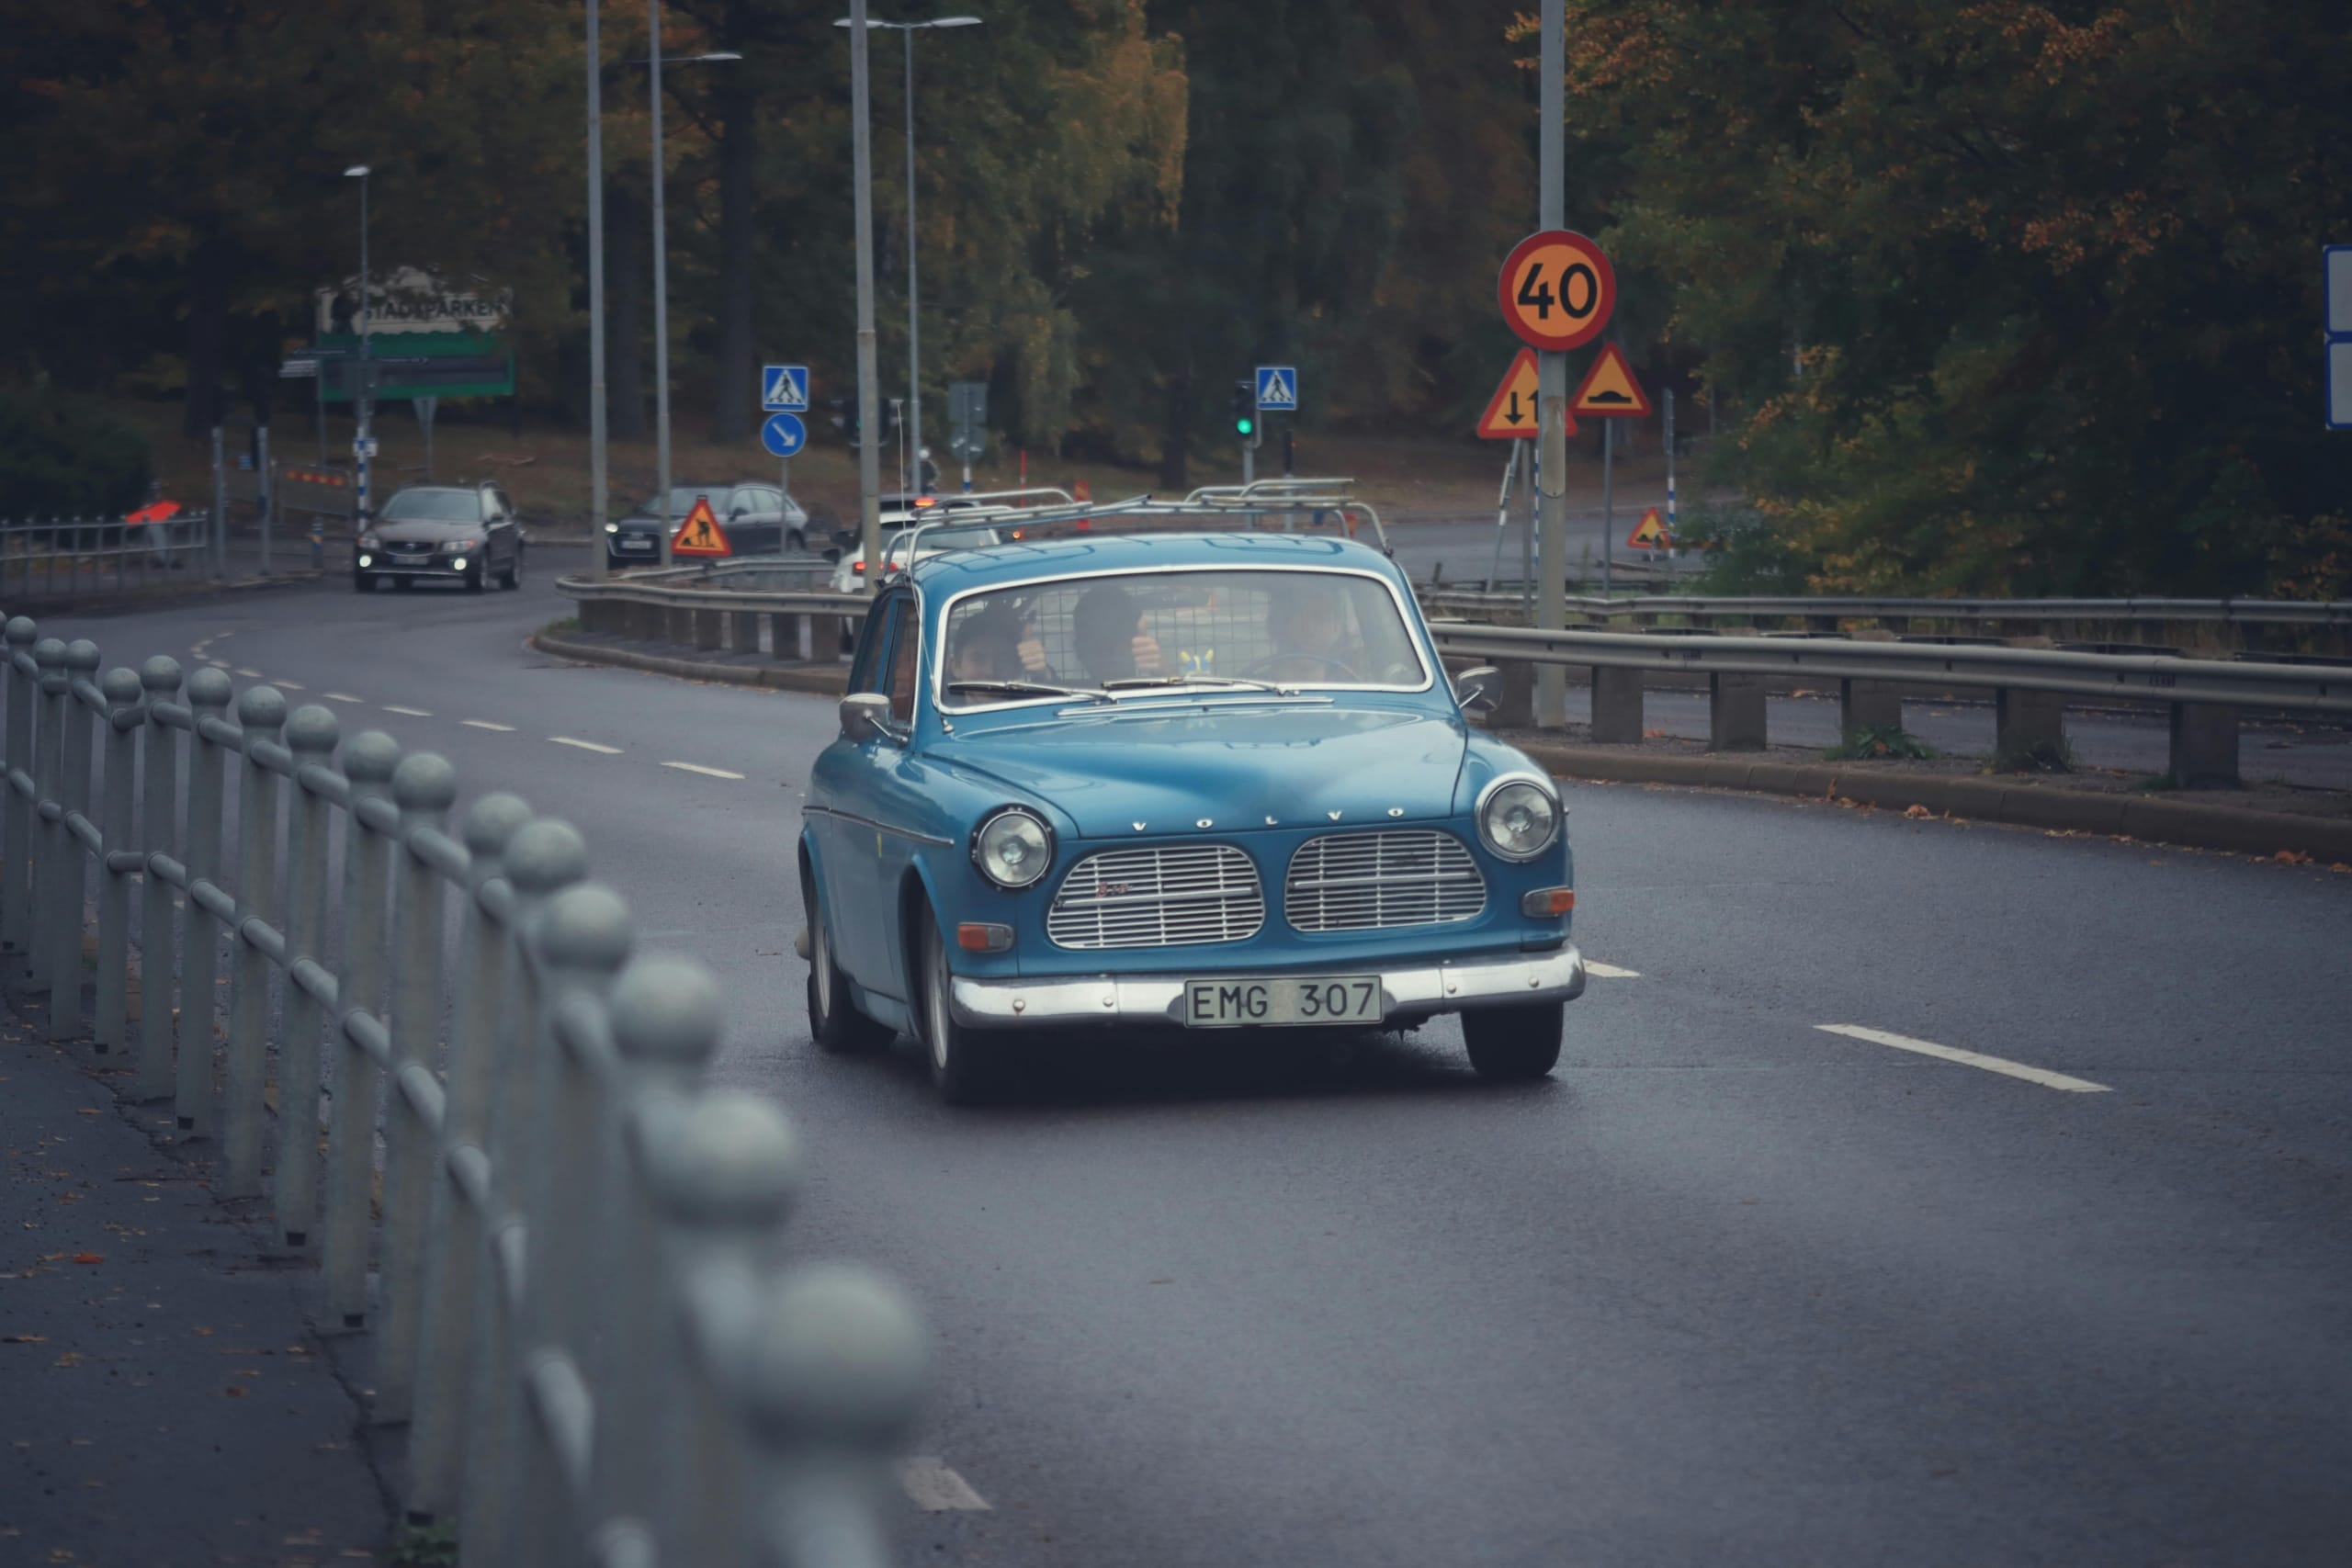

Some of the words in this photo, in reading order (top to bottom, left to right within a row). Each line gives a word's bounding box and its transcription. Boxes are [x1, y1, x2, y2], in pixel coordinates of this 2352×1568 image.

[1517, 262, 1598, 320] 40
[1132, 807, 1405, 831] VOLVO
[1193, 985, 1268, 1020] EMG
[1298, 982, 1375, 1017] 307
